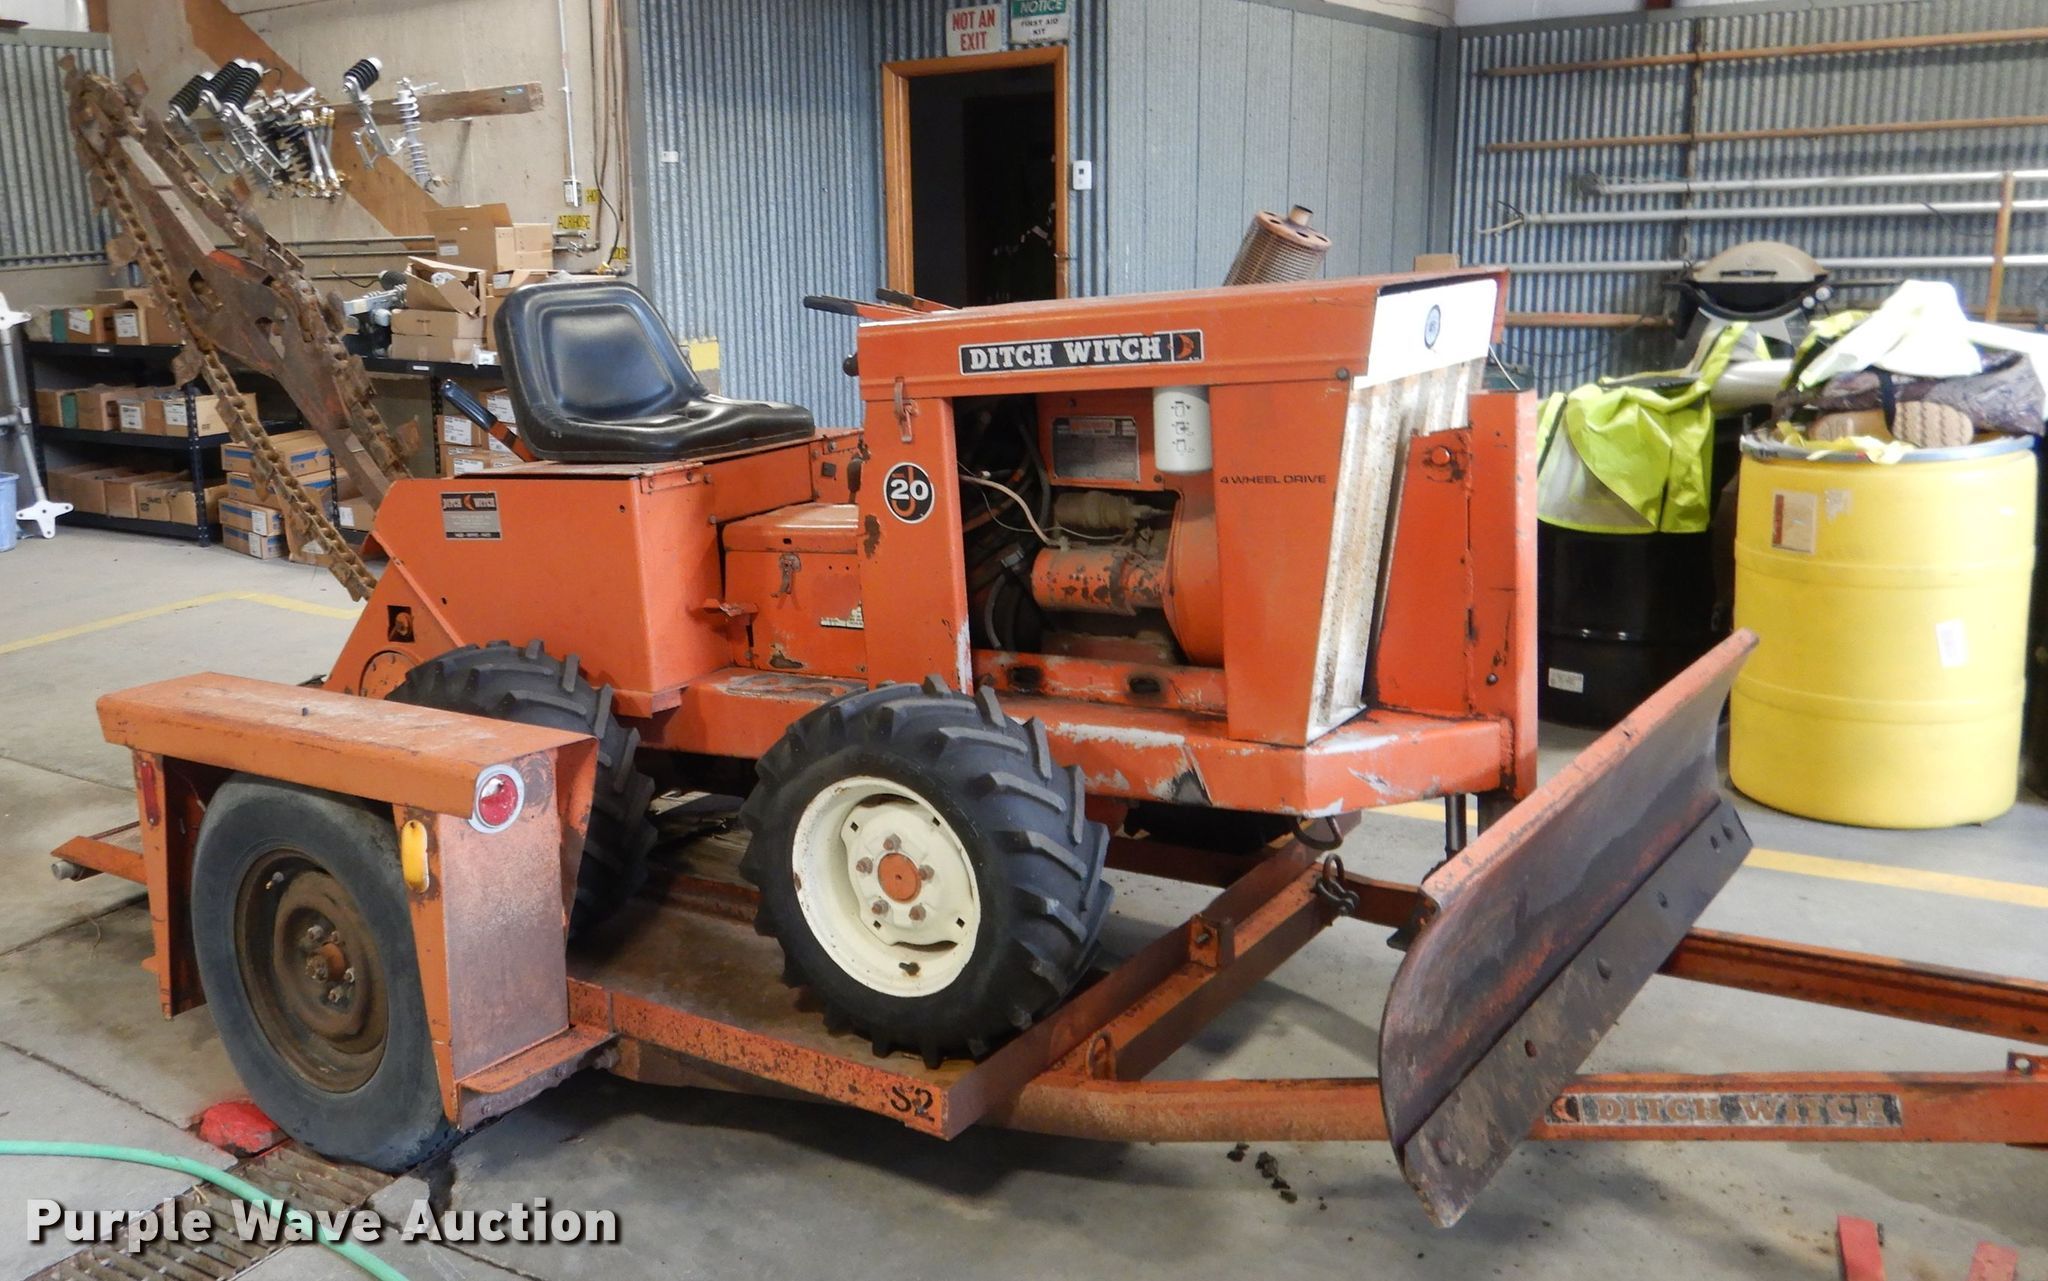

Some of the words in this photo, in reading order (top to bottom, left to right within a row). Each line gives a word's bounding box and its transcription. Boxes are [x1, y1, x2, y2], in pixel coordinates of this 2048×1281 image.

[1020, 0, 1063, 13] NOTICE
[952, 11, 976, 31] NOT
[978, 9, 996, 27] AN
[1021, 19, 1042, 27] FIRST
[960, 32, 987, 51] EXIT
[969, 344, 1053, 370] DITCH
[1063, 336, 1162, 363] WITCH
[890, 478, 929, 501] 20
[1231, 474, 1280, 484] WHEEL
[1283, 474, 1326, 484] DRIVE
[890, 1086, 936, 1122] S2
[1596, 1096, 1721, 1122] DITCH
[1738, 1095, 1885, 1123] WITCH
